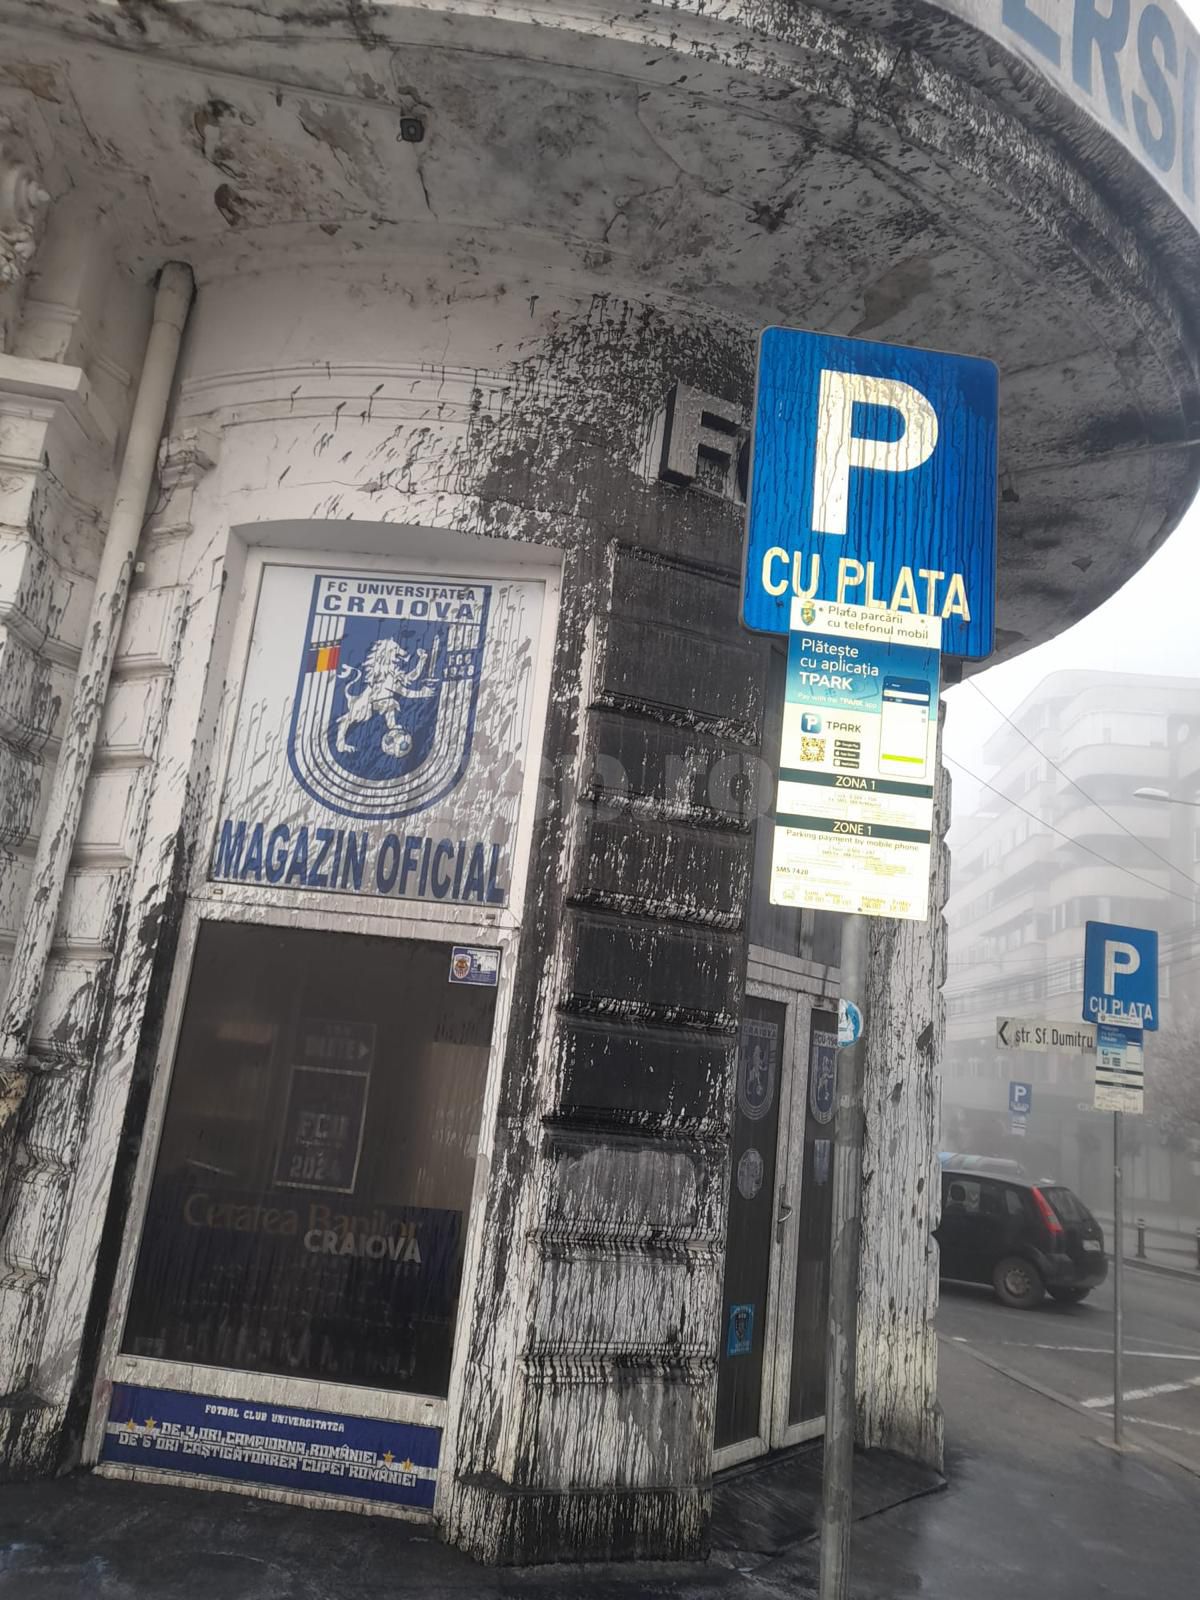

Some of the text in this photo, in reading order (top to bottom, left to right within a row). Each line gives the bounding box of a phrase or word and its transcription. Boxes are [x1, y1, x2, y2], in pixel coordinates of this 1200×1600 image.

[811, 368, 939, 535] P
[327, 580, 476, 602] FC UNIVERSITATEA
[761, 546, 971, 622] CU PLATA
[322, 593, 475, 621] CRAIOVA
[827, 619, 929, 640] cu telefonul mobil
[801, 638, 859, 659] Plătește
[800, 657, 880, 678] cu aplicația
[799, 671, 853, 691] TPARK
[826, 721, 862, 733] TPARK
[835, 776, 876, 790] ZONA 1
[832, 821, 872, 835] ZONE 1
[786, 829, 919, 853] Parking payment by mobile phone
[213, 819, 506, 904] MAGAZIN OFICIAL
[776, 865, 791, 873] SMS
[1103, 939, 1141, 995] P
[1089, 996, 1107, 1014] CU
[1112, 999, 1153, 1020] PLATA
[1015, 1029, 1032, 1043] str.
[1035, 1029, 1048, 1045] Sf.
[1052, 1029, 1093, 1048] Dumitru
[1014, 1085, 1027, 1101] P
[304, 1229, 421, 1263] CRAIOVA
[205, 1404, 345, 1433] FOTBAL CLUB UNIVERSITATEA
[161, 1421, 179, 1436] DE
[200, 1427, 222, 1443] ORI
[118, 1431, 139, 1446] DE
[155, 1437, 179, 1452] ORI
[302, 1458, 345, 1477] CUPEI
